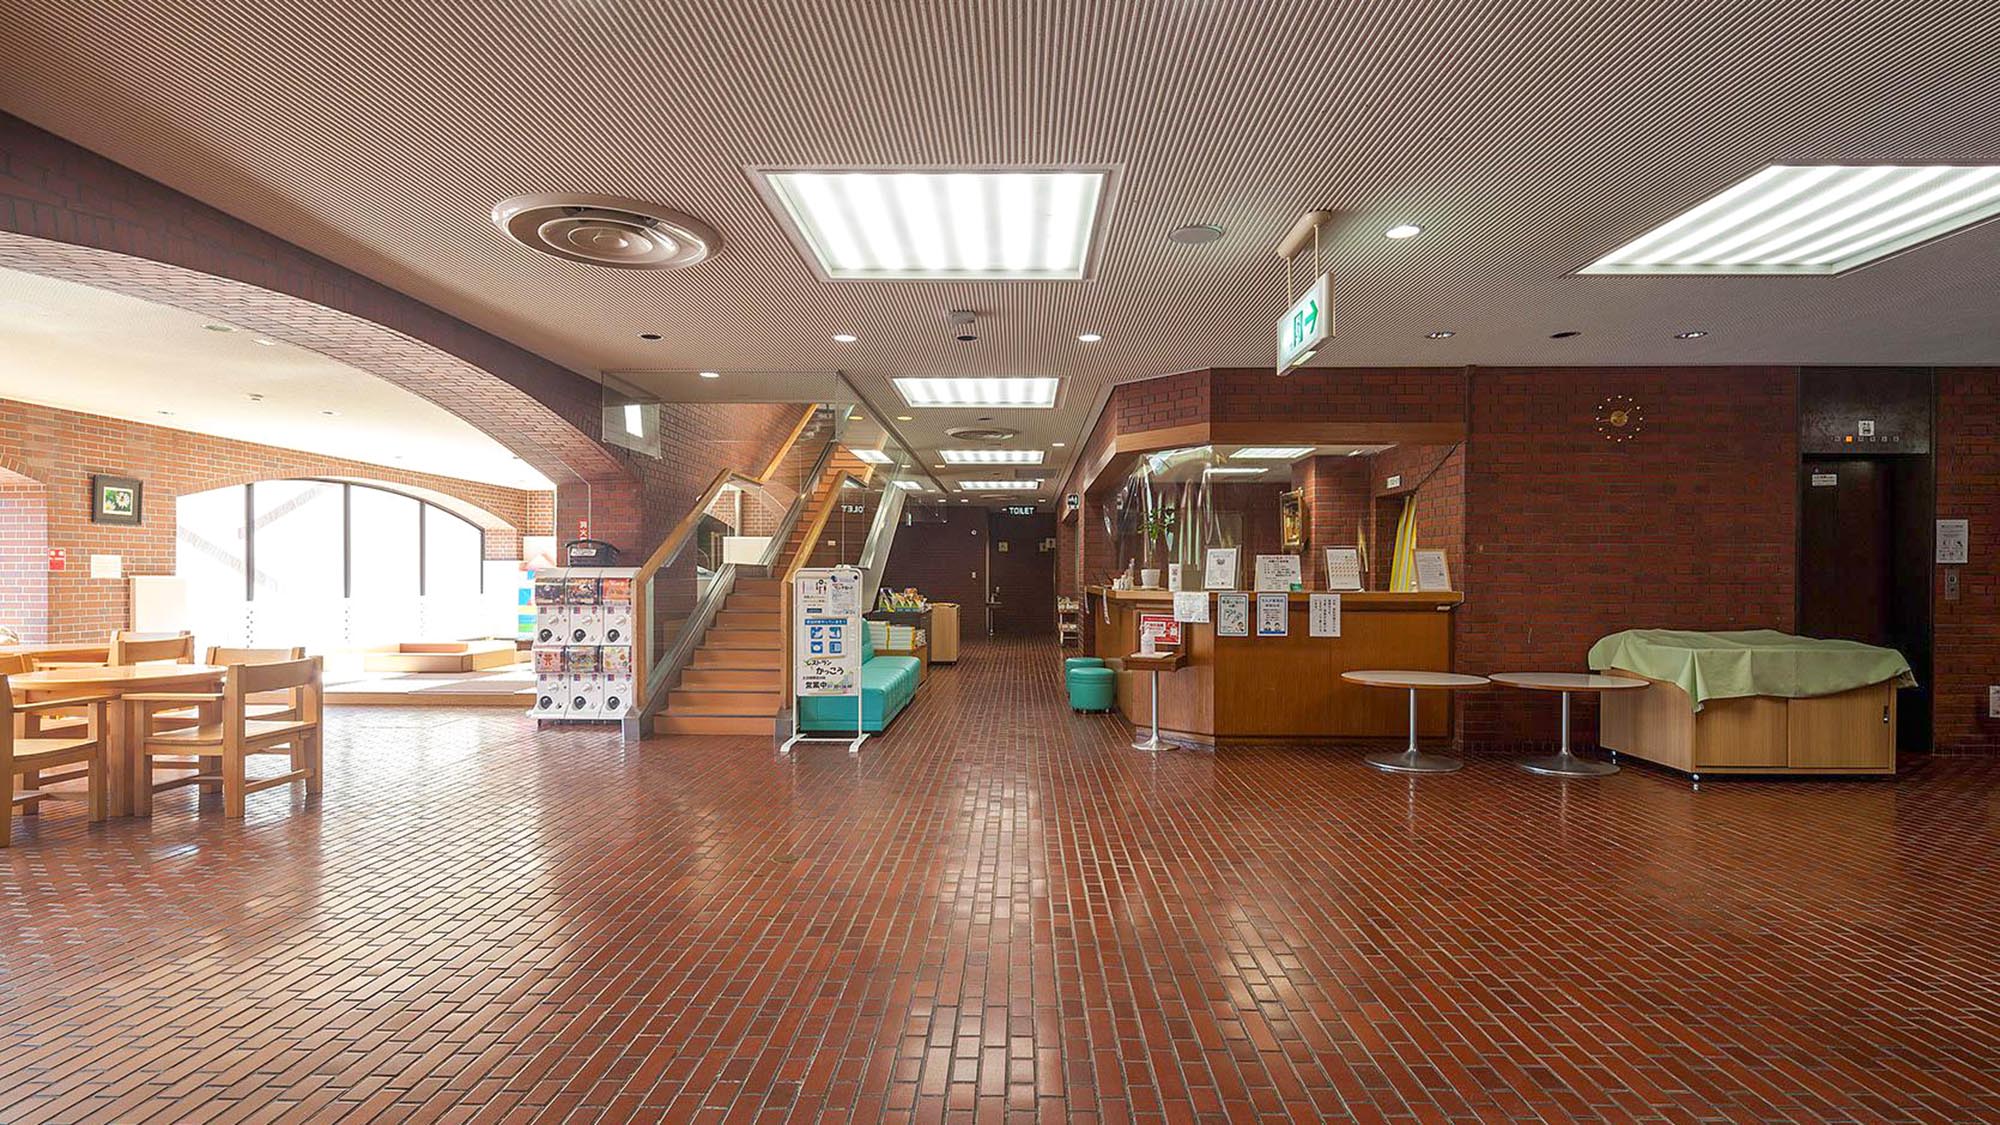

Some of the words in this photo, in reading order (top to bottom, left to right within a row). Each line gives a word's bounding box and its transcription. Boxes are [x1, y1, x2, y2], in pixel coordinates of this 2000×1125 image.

[1008, 507, 1034, 515] TOILET
[579, 520, 588, 541] 消火
[815, 667, 844, 675] かっこう
